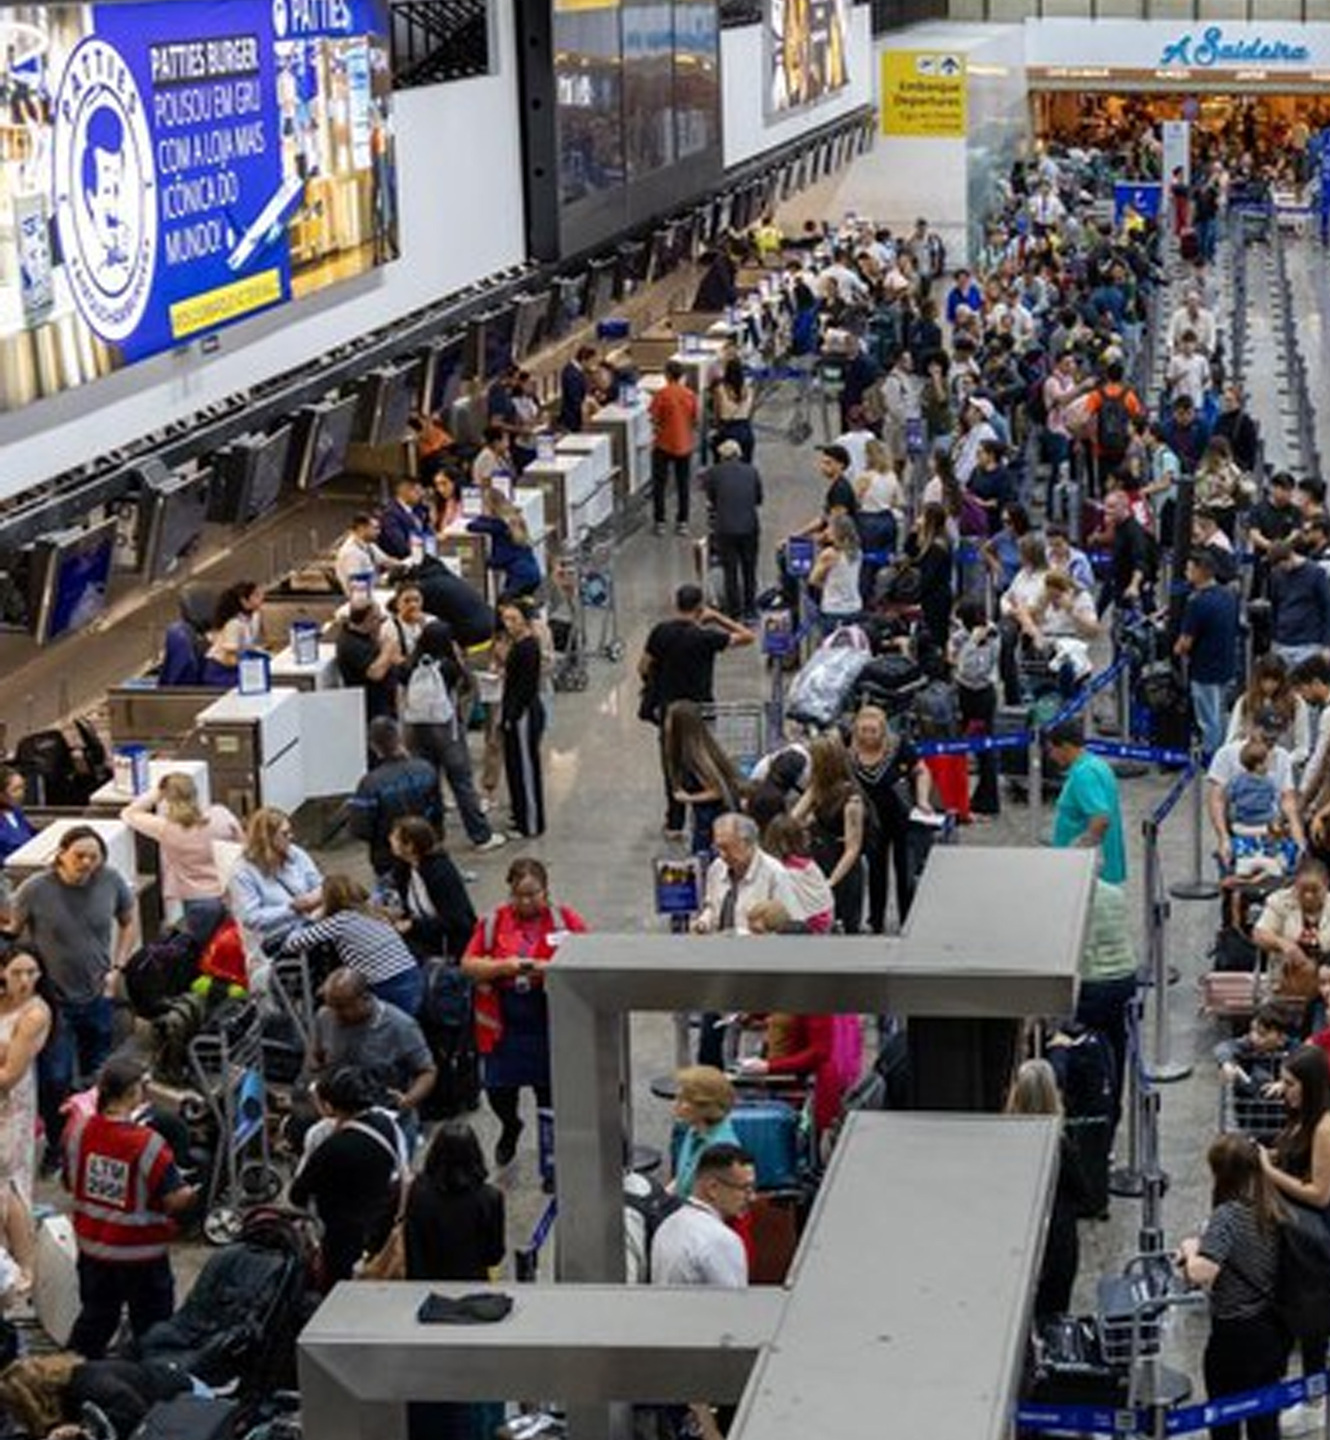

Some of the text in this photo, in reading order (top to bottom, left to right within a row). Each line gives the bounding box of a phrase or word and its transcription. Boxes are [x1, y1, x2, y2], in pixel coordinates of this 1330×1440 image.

[151, 37, 258, 82] PATTIES BURGER
[1160, 26, 1309, 66] A Saideira
[154, 78, 260, 127] POUSOU EM GRU
[893, 94, 960, 108] Departures
[899, 80, 959, 93] Embarque
[159, 135, 191, 173] COM
[204, 127, 233, 169] LOJA
[234, 119, 266, 156] MAIS
[162, 170, 239, 221] ICÔNICA DO
